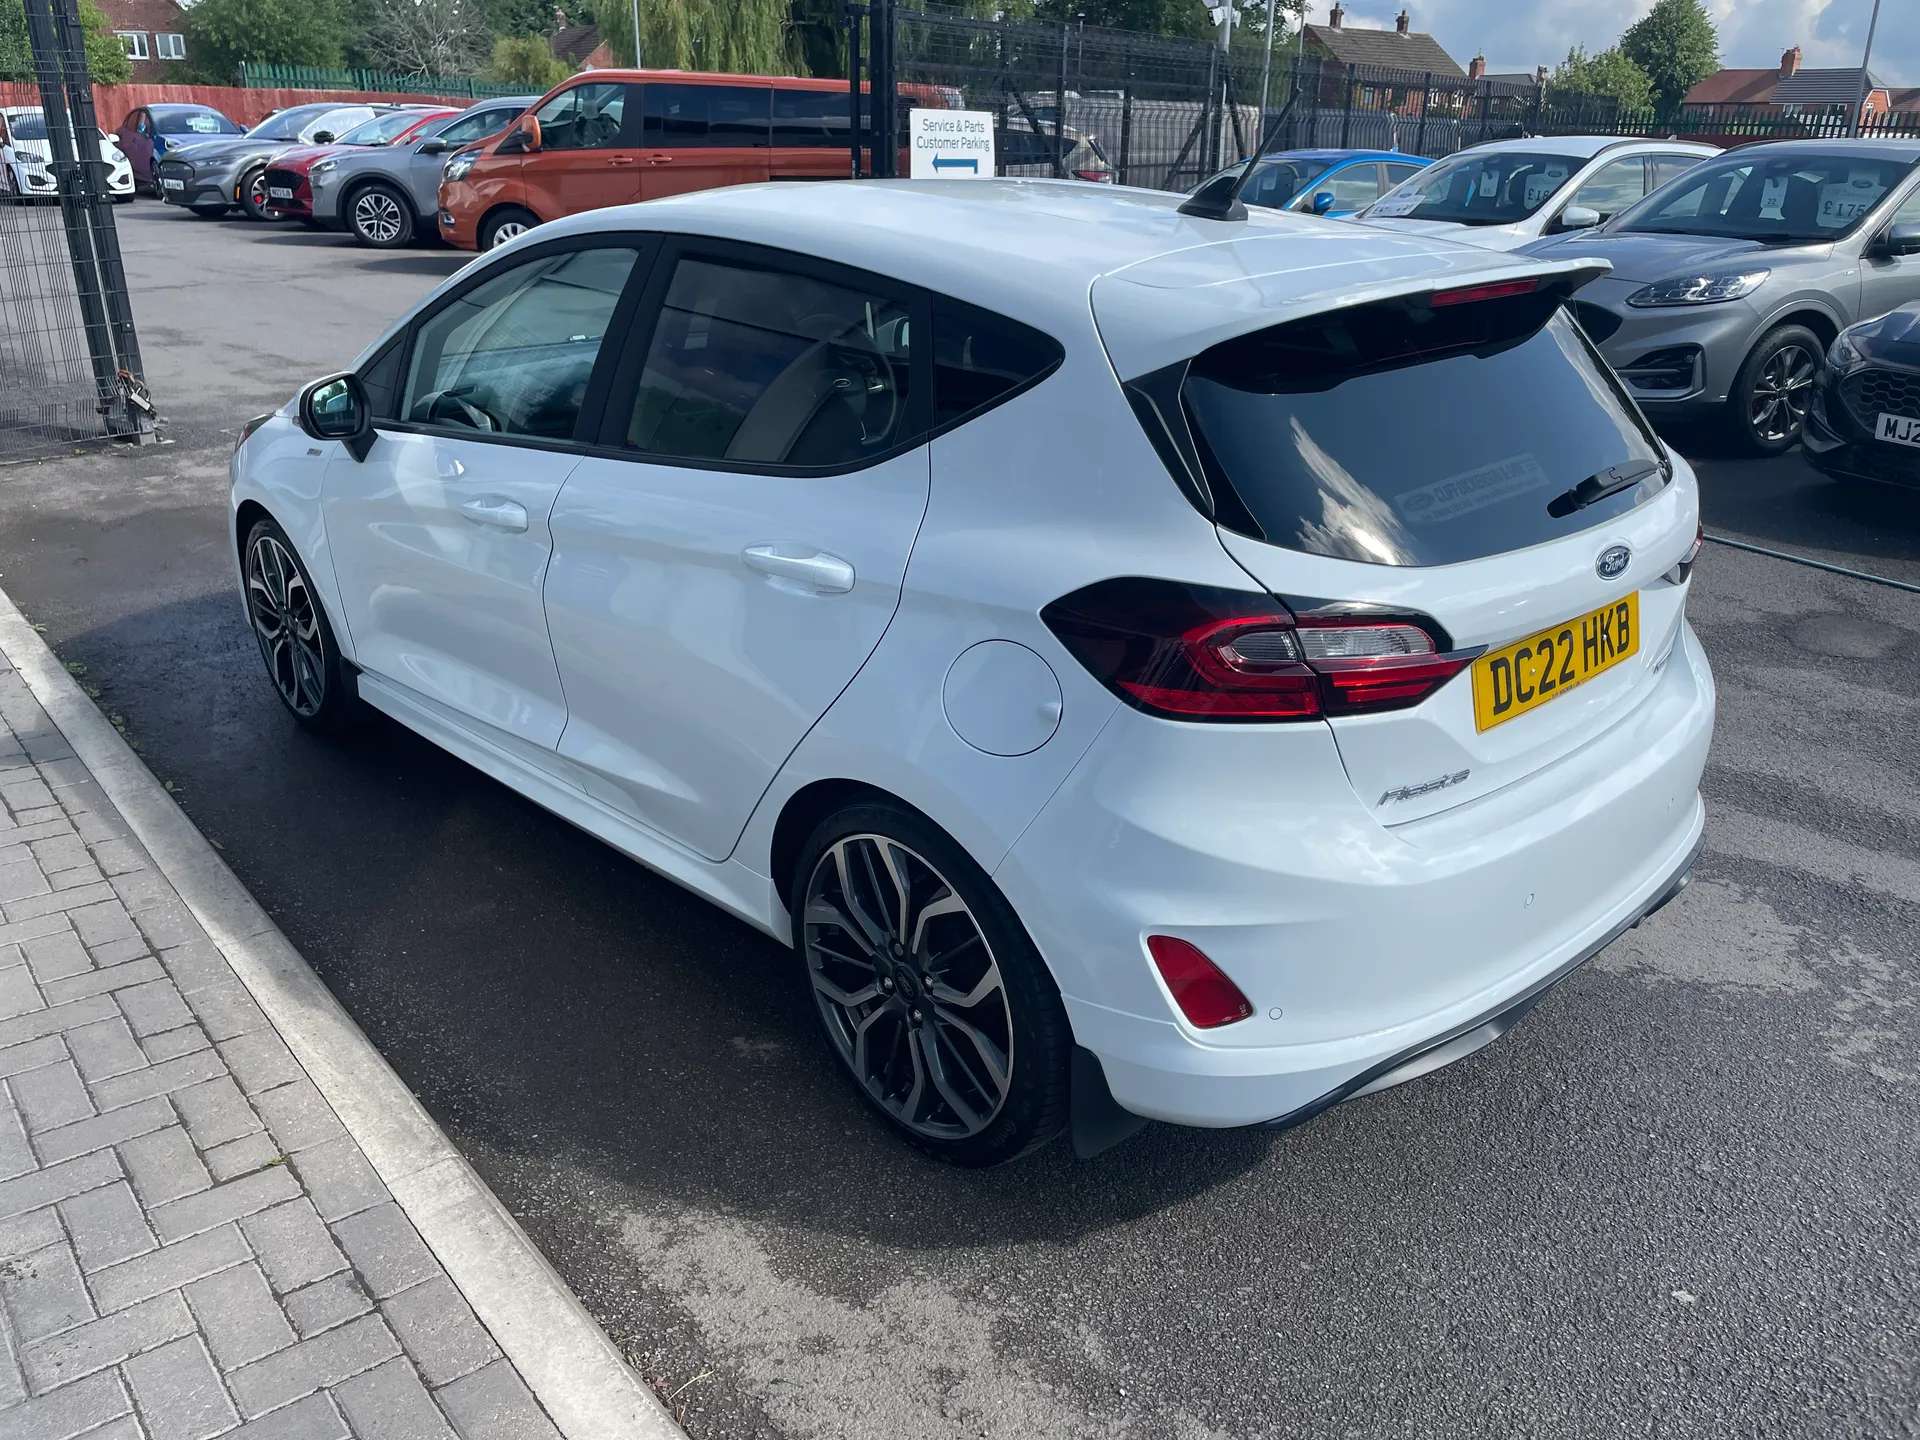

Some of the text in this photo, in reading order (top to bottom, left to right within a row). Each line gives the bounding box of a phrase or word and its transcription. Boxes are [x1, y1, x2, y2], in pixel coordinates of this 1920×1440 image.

[922, 118, 985, 133] Service & Parts
[916, 135, 990, 152] Customer Parking
[1604, 550, 1627, 572] Ford
[1489, 601, 1630, 716] DC22 HKB
